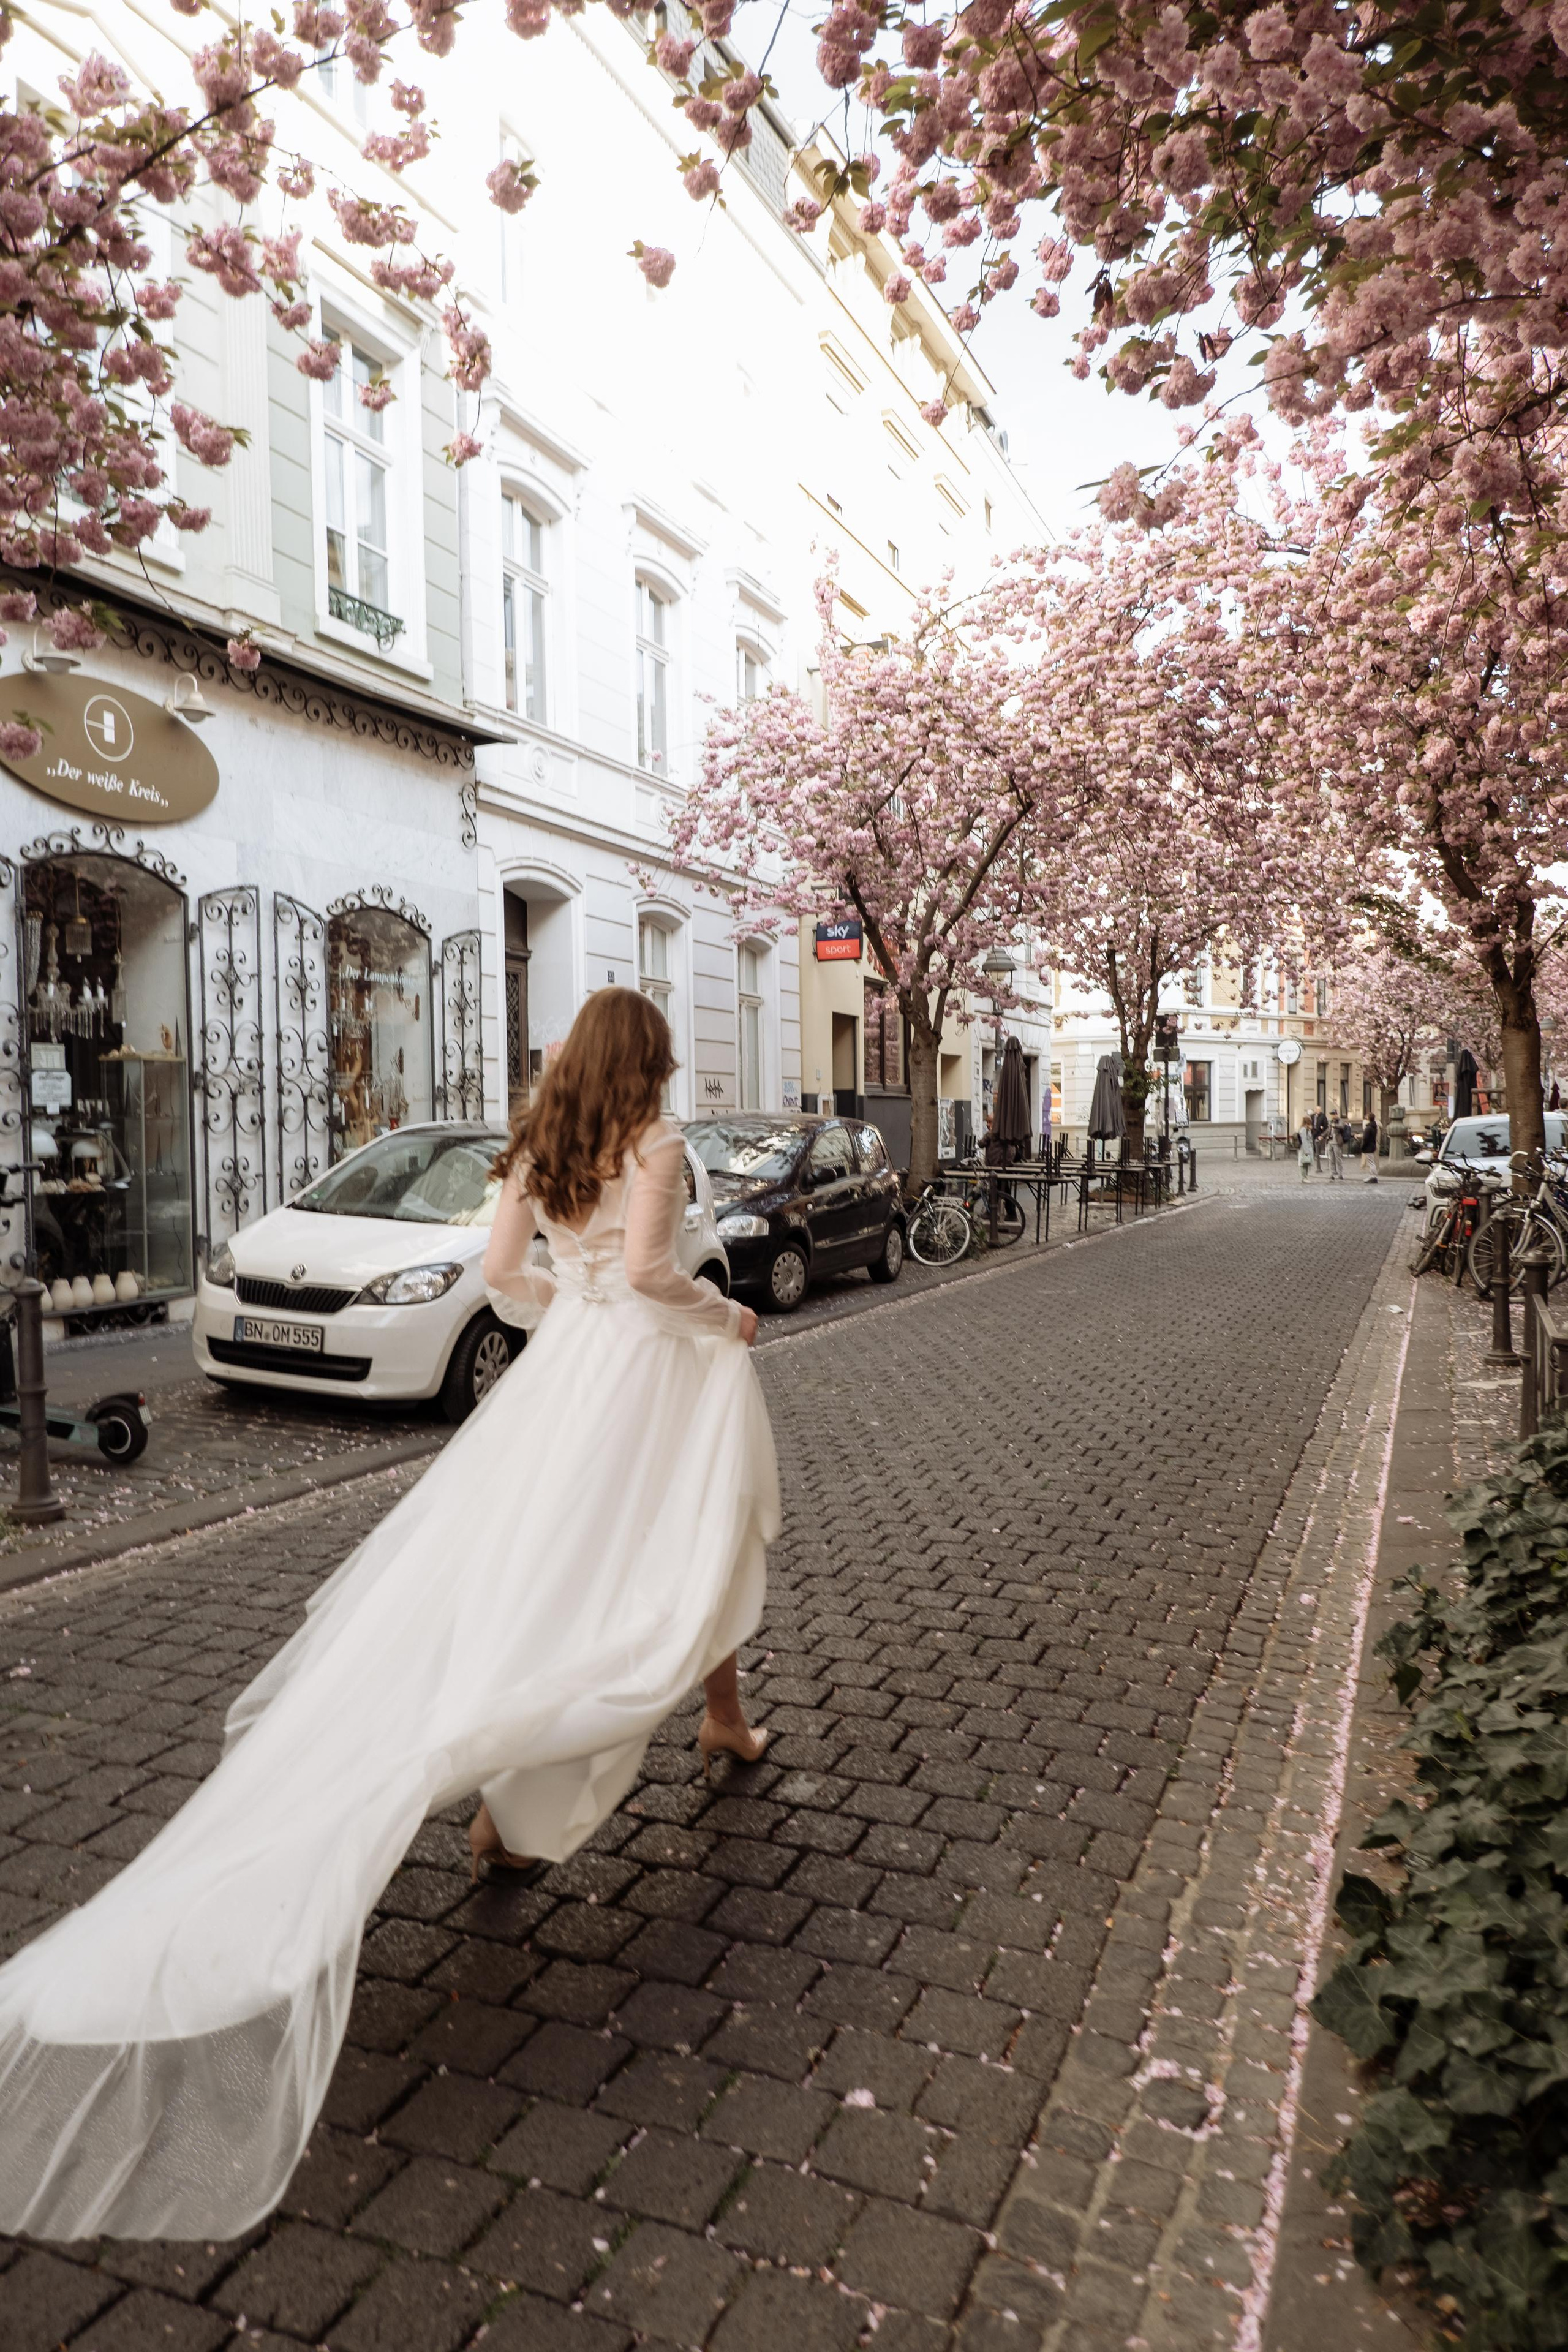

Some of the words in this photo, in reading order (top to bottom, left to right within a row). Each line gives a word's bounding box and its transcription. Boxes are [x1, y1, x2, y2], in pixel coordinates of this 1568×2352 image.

[87, 771, 124, 793] weiße
[827, 924, 850, 939] sky
[825, 944, 851, 956] sport
[244, 1322, 263, 1339] BN
[273, 1325, 290, 1343] OM
[293, 1328, 319, 1346] 555
